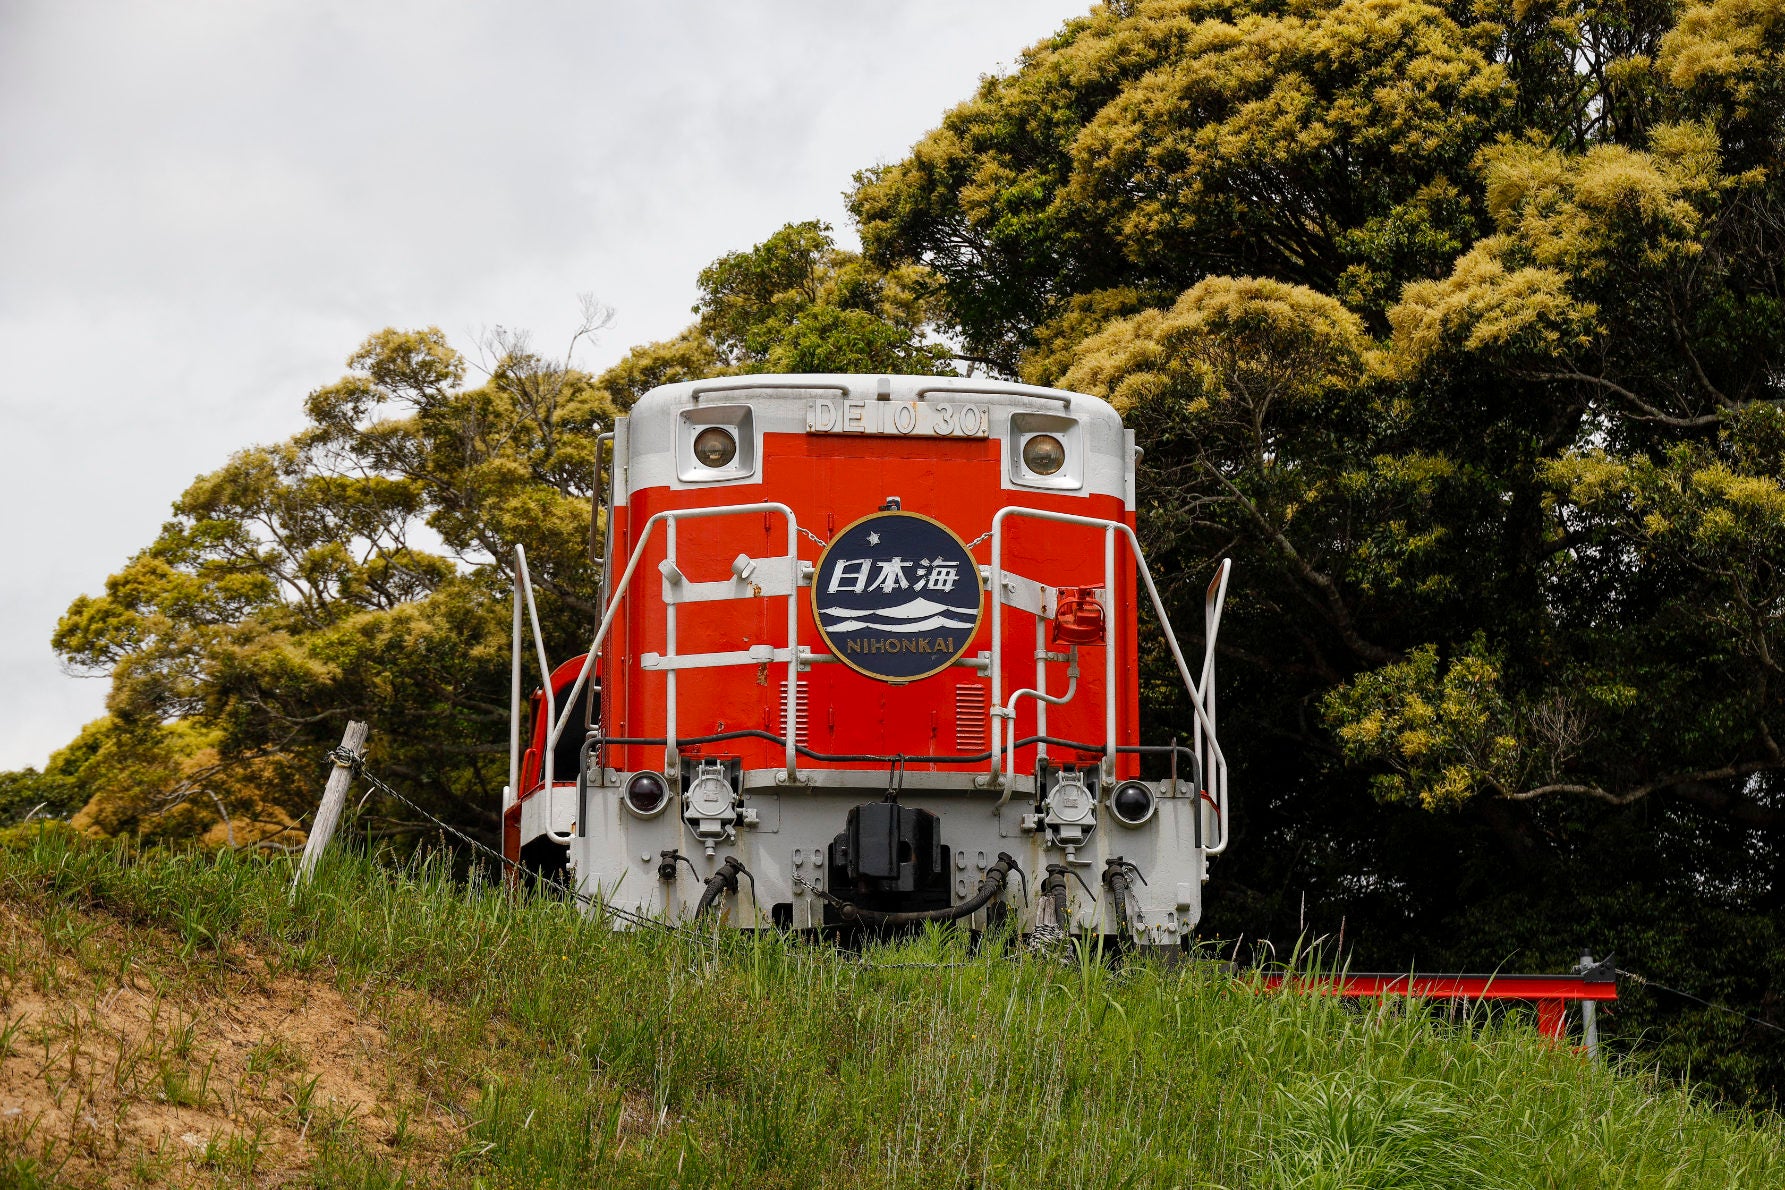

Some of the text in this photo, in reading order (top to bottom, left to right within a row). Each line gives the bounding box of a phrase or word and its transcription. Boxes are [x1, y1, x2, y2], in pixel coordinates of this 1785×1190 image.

[932, 402, 981, 436] 30
[827, 555, 960, 594] 日本海
[847, 637, 954, 655] NIHONKAI
